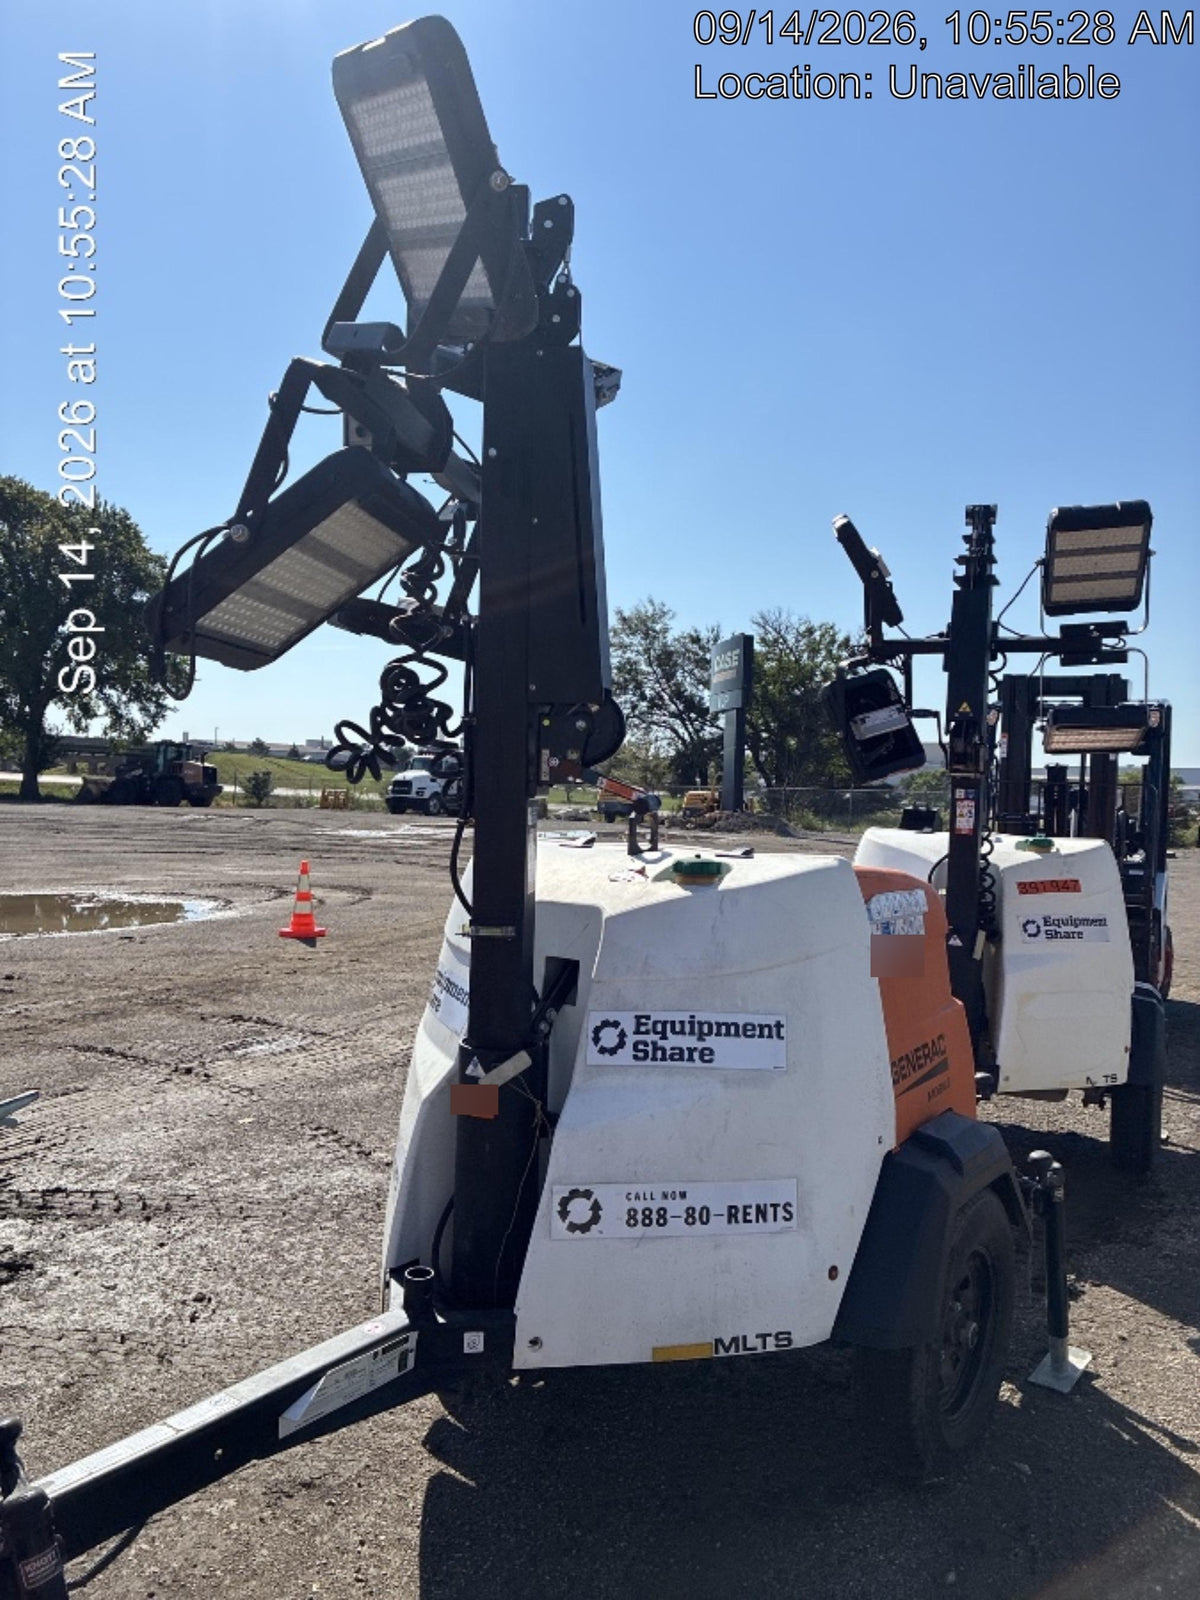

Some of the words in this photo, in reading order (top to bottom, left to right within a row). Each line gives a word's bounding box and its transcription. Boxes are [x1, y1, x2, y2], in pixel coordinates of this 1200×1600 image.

[1044, 929, 1084, 940] Share
[632, 1015, 785, 1042] Equipment
[632, 1040, 716, 1064] Share
[891, 1033, 946, 1086] GENERAC
[626, 1191, 656, 1202] CALL
[661, 1190, 688, 1201] NOW
[625, 1202, 794, 1228] 888-80-RENTS
[714, 1331, 793, 1355] MLTS
